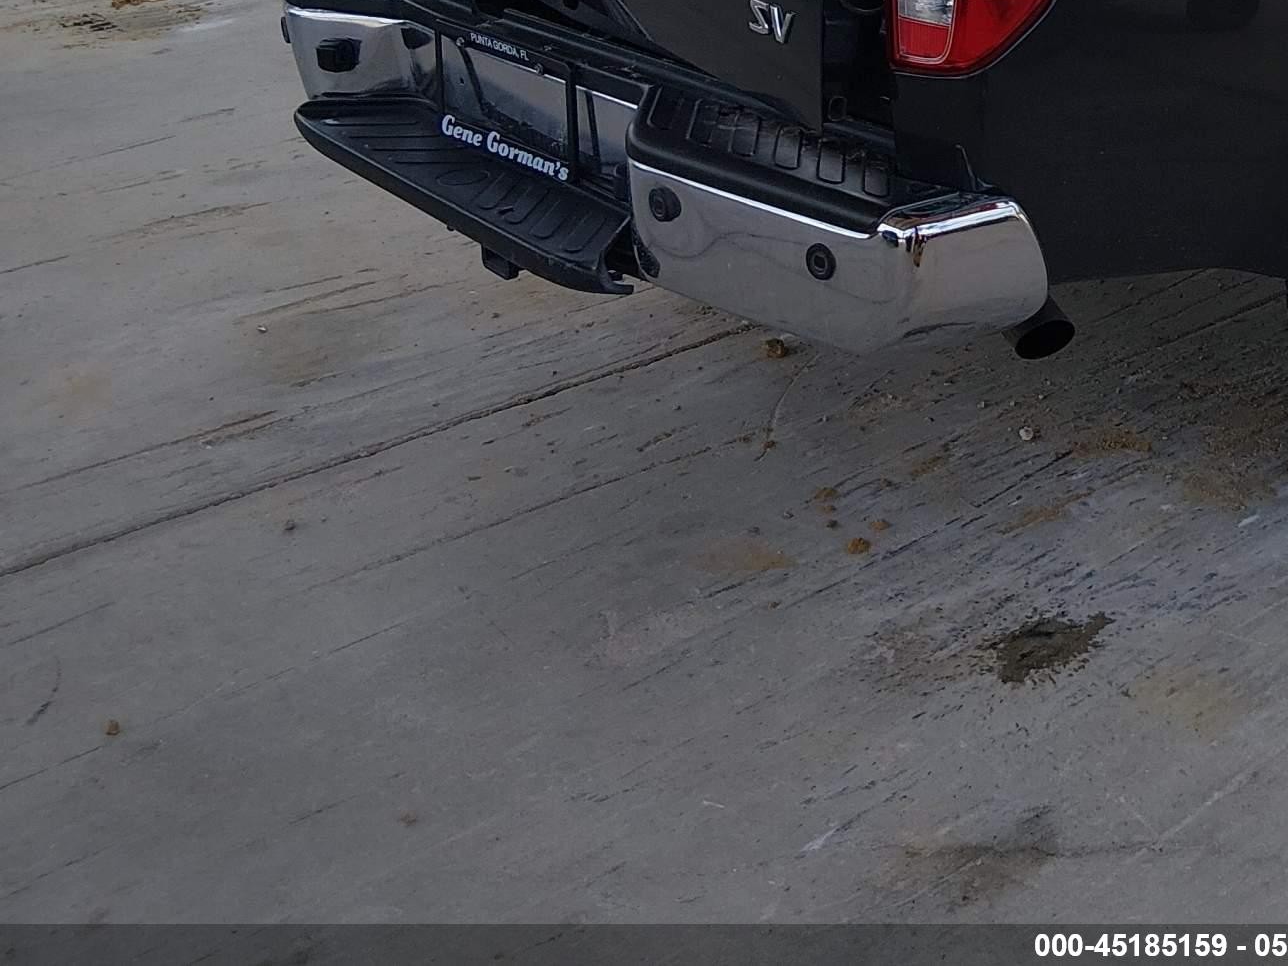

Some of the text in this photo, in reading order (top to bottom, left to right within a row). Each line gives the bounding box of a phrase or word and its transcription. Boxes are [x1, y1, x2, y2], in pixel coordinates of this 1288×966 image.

[470, 33, 493, 48] PUNTA
[520, 50, 529, 61] FL
[441, 114, 569, 181] Gene Gorman's
